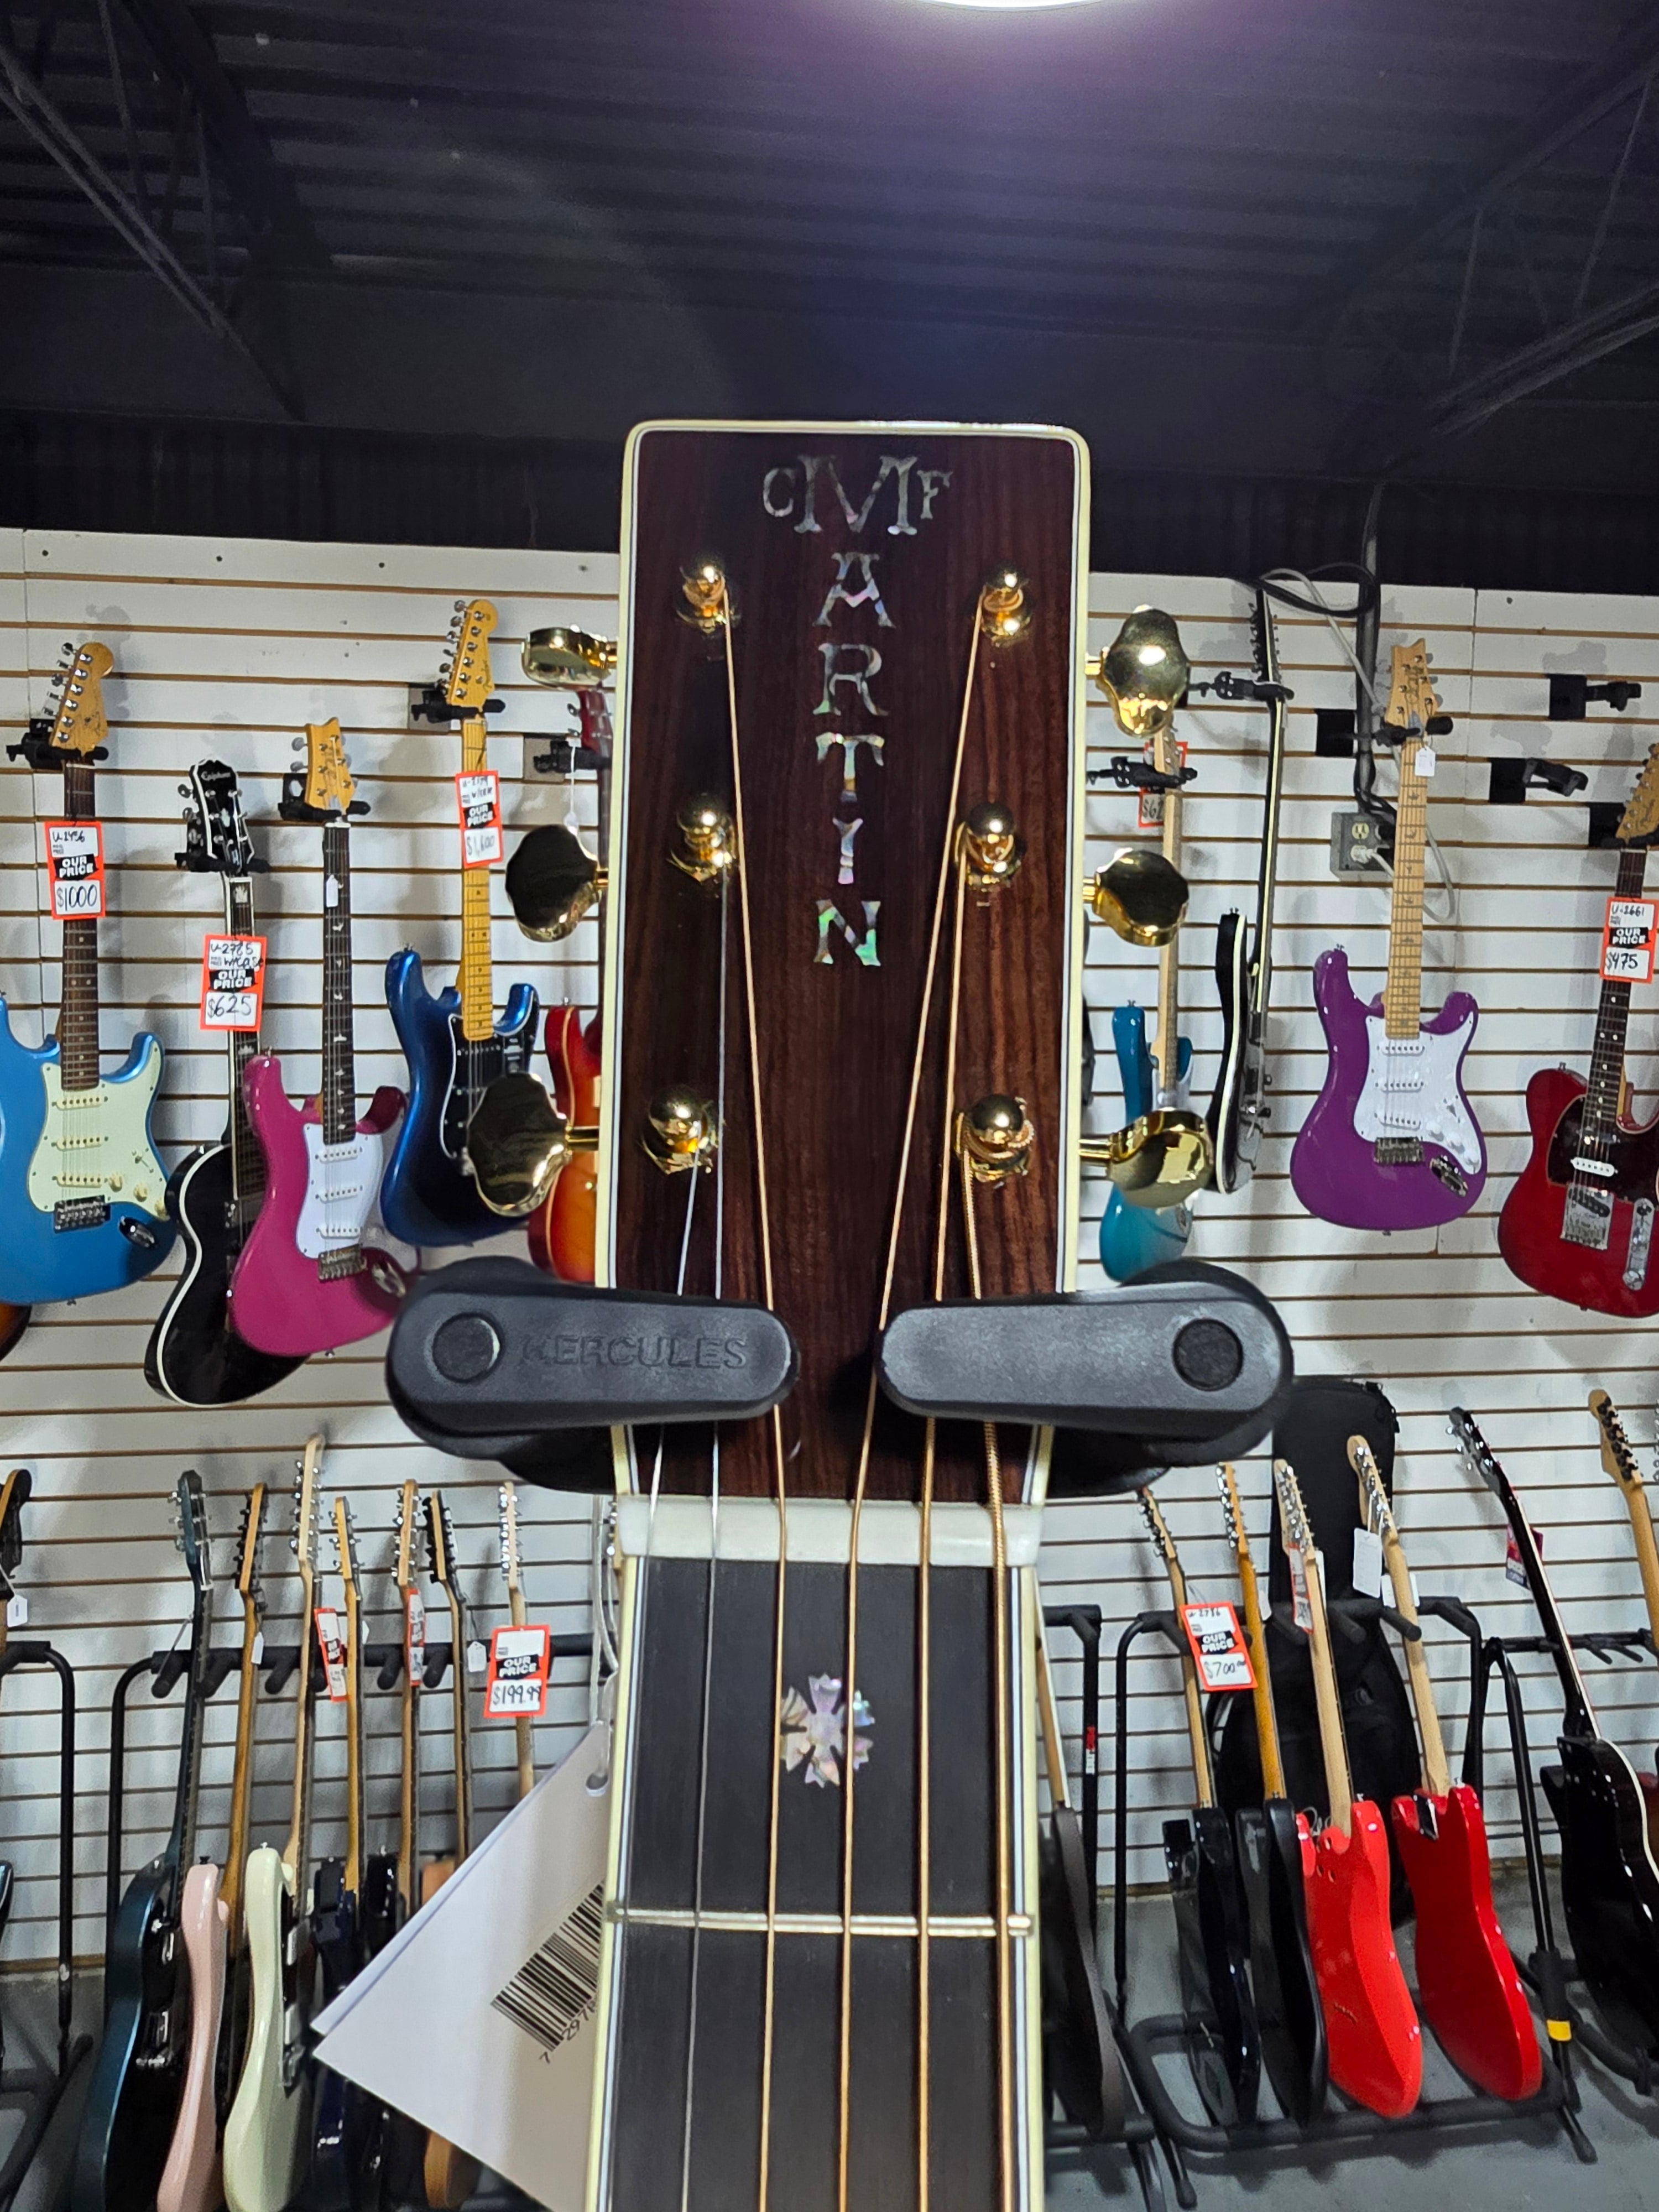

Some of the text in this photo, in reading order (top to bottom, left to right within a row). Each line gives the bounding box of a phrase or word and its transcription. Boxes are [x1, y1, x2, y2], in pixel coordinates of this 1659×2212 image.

[469, 804, 488, 816] OUR
[467, 811, 494, 827] PRICE
[62, 856, 87, 868] OUR
[59, 863, 93, 878] PRICE
[56, 884, 97, 911] $1000
[1616, 928, 1641, 937] OUR
[1612, 935, 1646, 945] PRICE
[1606, 952, 1638, 971] $475
[218, 969, 246, 979] OUR
[213, 977, 252, 989] PRICE
[207, 995, 251, 1018] $625
[523, 1334, 747, 1369] HERCULES
[1202, 1632, 1227, 1644] OUR
[1201, 1638, 1234, 1652] PRICE
[504, 1656, 531, 1668] OUR
[499, 1663, 536, 1678] PRICE
[493, 1685, 541, 1705] $199.99
[539, 2052, 551, 2064] 7
